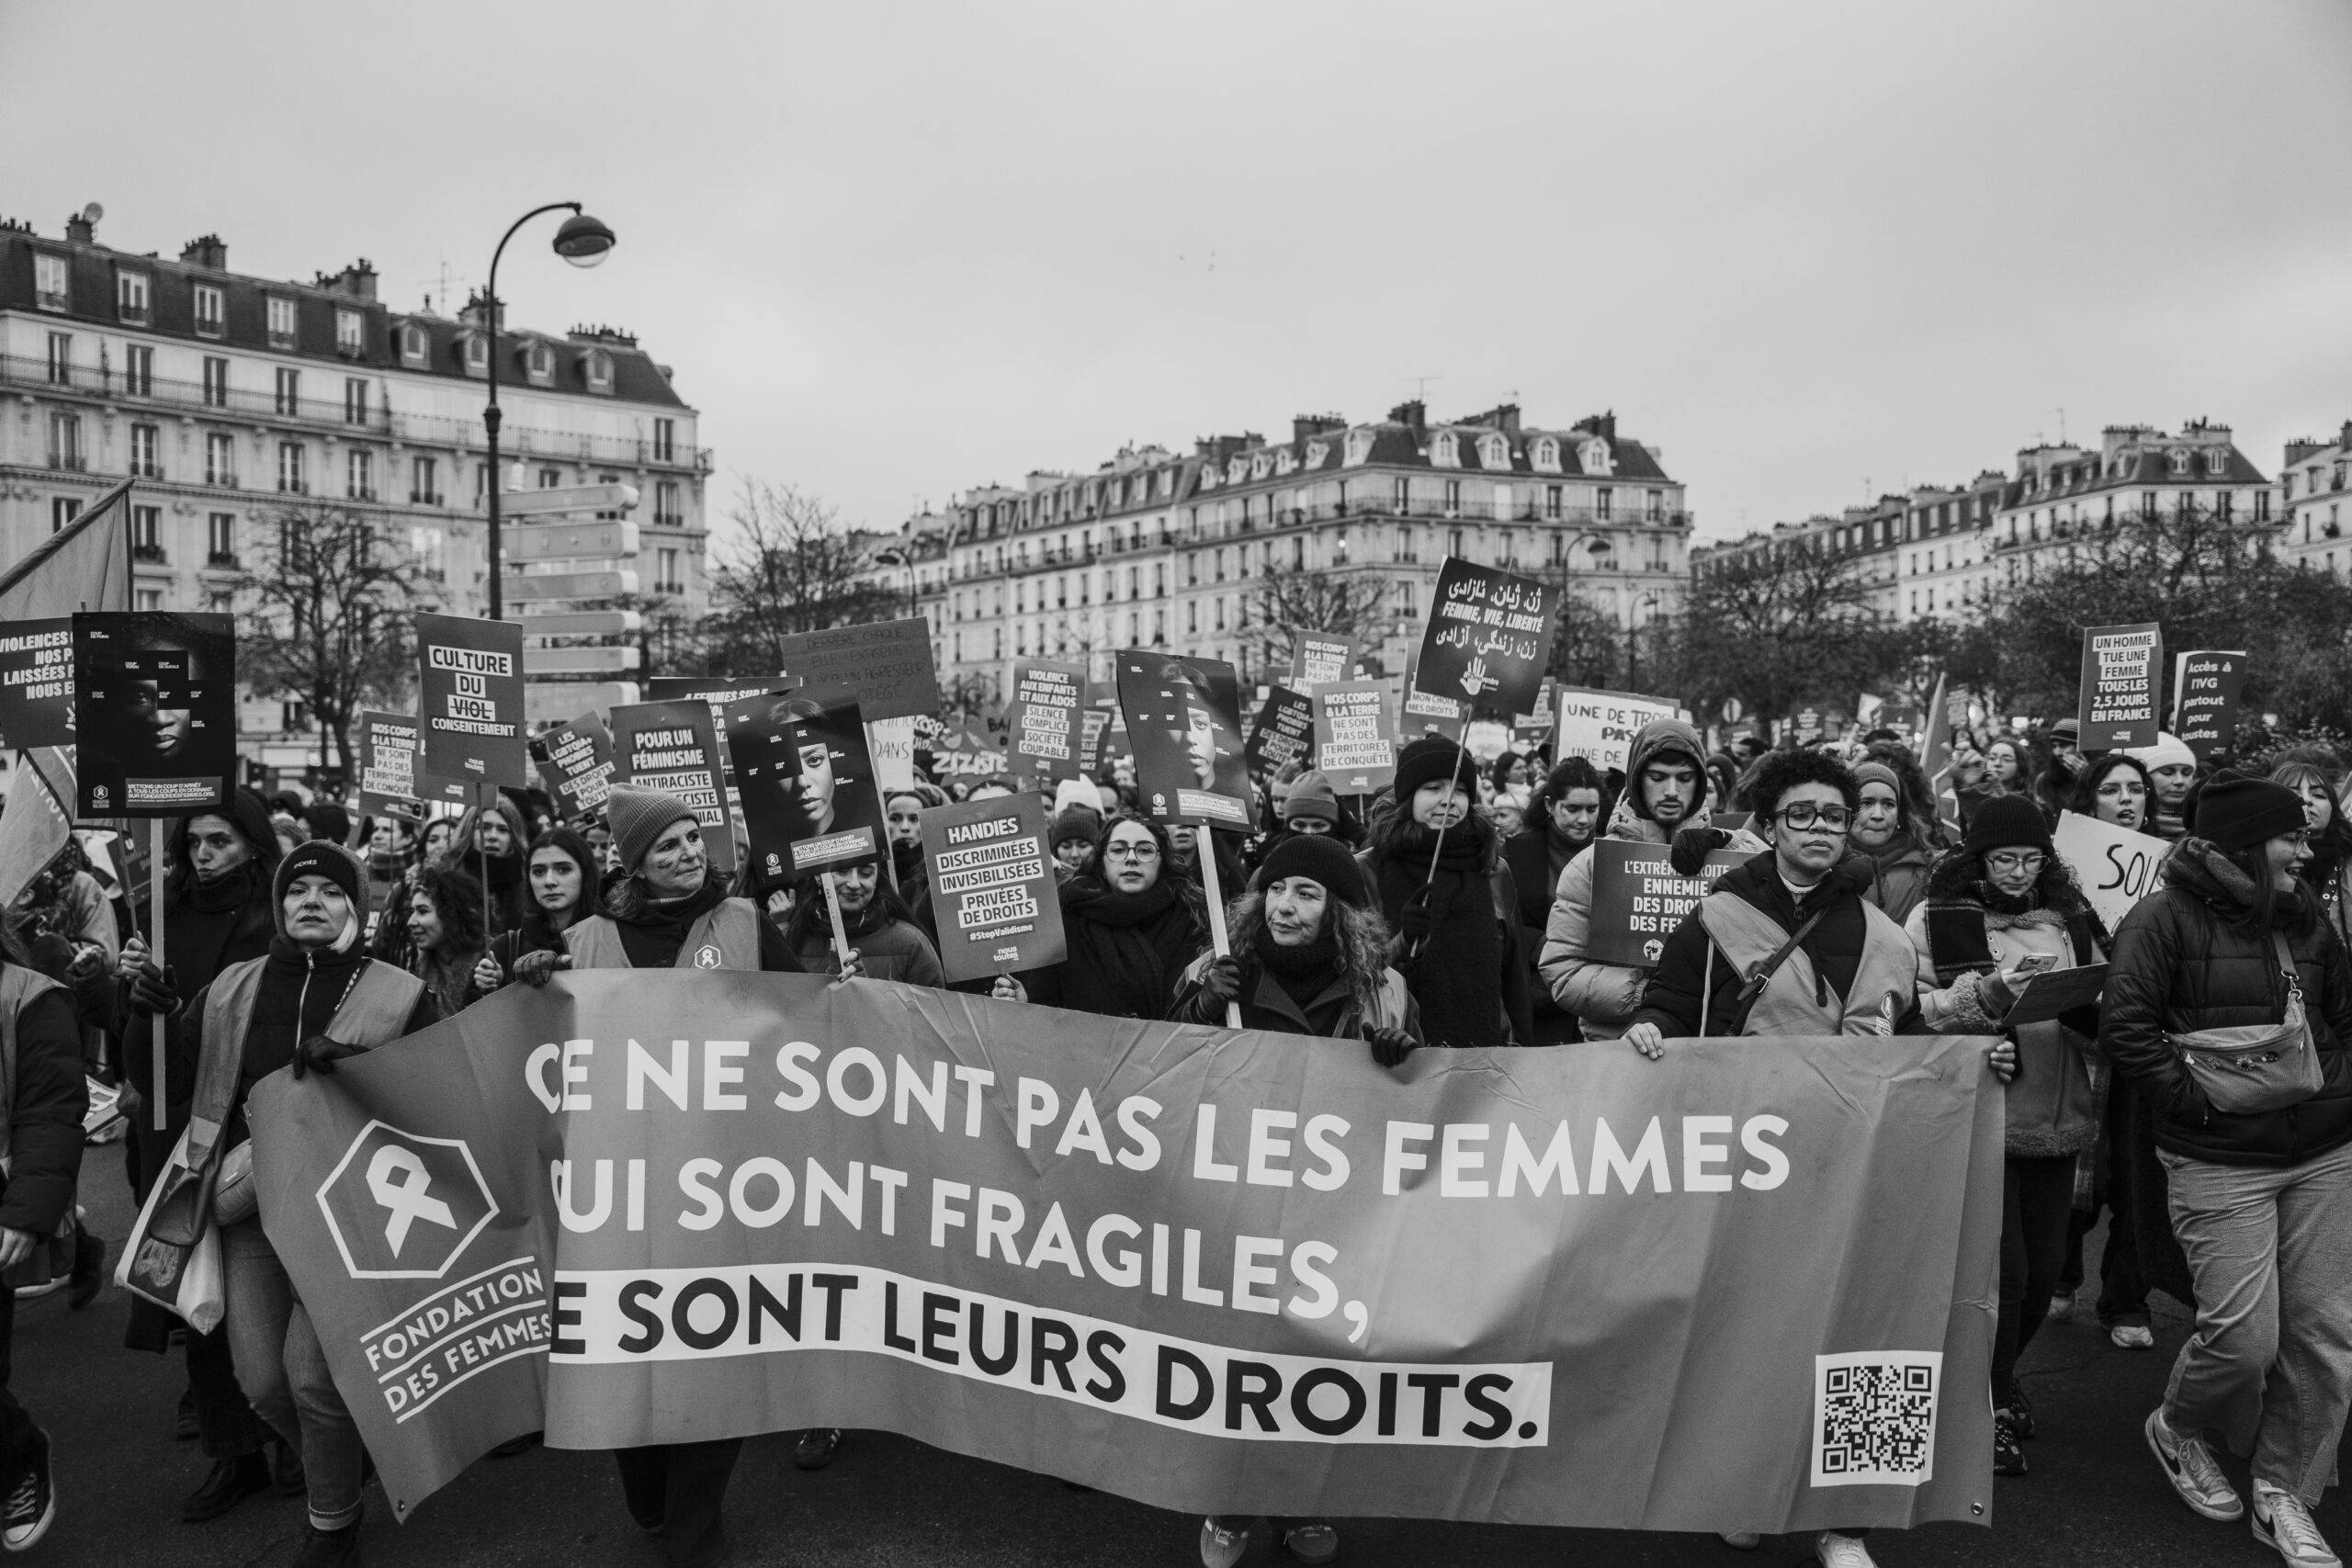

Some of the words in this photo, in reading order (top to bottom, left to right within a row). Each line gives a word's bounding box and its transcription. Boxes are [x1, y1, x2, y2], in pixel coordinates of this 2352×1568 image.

[1442, 601, 1481, 623] FEMME,
[1484, 609, 1504, 627] VIE,
[1506, 613, 1545, 634] LIBERTÉ
[1305, 640, 1323, 650] NOS
[1323, 643, 1349, 654] CORPS
[2096, 637, 2111, 649] UN
[2113, 635, 2152, 648] HOMME
[35, 649, 62, 665] NOS
[433, 648, 508, 674] CULTURE
[1311, 651, 1321, 660] LA
[1323, 652, 1347, 664] TERRE
[2103, 651, 2124, 662] TUE
[2126, 649, 2146, 661] UNE
[1319, 663, 1340, 672] SONT
[2105, 664, 2143, 678] FEMME
[2188, 660, 2219, 674] Accès
[2222, 661, 2233, 672] à
[4, 665, 65, 686] LAISSÉES
[1028, 670, 1069, 683] VIOLENCE
[26, 682, 56, 700] NOUS
[459, 676, 481, 694] DU
[857, 681, 905, 703] OTÉGÉ
[1020, 680, 1039, 691] AUX
[1038, 682, 1077, 696] ENFANTS
[2097, 680, 2129, 693] TOUS
[2130, 679, 2148, 692] LES
[1019, 691, 1031, 702] ET
[1031, 692, 1049, 705] AUX
[1050, 694, 1077, 708] ADOS
[1324, 694, 1346, 705] NOS
[1347, 692, 1380, 704] CORPS
[1412, 694, 1430, 703] MON
[2093, 695, 2112, 708] 2,5
[2112, 694, 2149, 706] JOURS
[2183, 695, 2224, 711] partout
[453, 699, 491, 719] VIOL
[1029, 705, 1064, 719] SILENCE
[1326, 706, 1334, 717] &
[1335, 706, 1350, 716] LA
[1351, 705, 1381, 716] TERRE
[1408, 704, 1425, 712] MES
[1425, 705, 1453, 715] DROITS
[1567, 704, 1601, 719] UNE
[1608, 707, 1626, 724] DE
[2091, 710, 2107, 722] EN
[2108, 707, 2152, 721] FRANCE
[432, 716, 515, 737] CONSENTEMENT
[1023, 716, 1068, 731] COMPLICE
[1334, 719, 1347, 728] NE
[1348, 718, 1374, 728] SONT
[2187, 713, 2212, 727] pour
[371, 723, 390, 733] NOS
[390, 726, 417, 738] CORPS
[558, 730, 576, 745] LES
[635, 731, 673, 749] POUR
[673, 728, 694, 745] UN
[1336, 731, 1356, 740] PAS
[1359, 730, 1375, 739] DES
[1601, 727, 1636, 743] PAS
[379, 736, 390, 746] LA
[390, 738, 416, 750] TERRE
[1021, 742, 1067, 758] COUPABLE
[1324, 742, 1387, 754] TERRITOIRES
[389, 750, 411, 759] SONT
[632, 748, 705, 771] FÉMINISME
[1324, 758, 1337, 766] DE
[1338, 754, 1390, 766] CONQUÊTE
[1604, 750, 1623, 763] DE
[378, 760, 393, 770] PAS
[395, 761, 410, 772] DES
[565, 756, 596, 776] TUENT
[367, 769, 414, 783] TERRITOIRE
[562, 779, 581, 793] DES
[579, 765, 613, 784] DROITS
[366, 781, 376, 789] DE
[580, 779, 605, 796] POUR
[579, 786, 611, 808] TOUTE
[947, 818, 1019, 844] HANDIES
[940, 840, 1036, 870] DISCRIMINÉES
[1624, 859, 1683, 876] L'EXTRÊM
[942, 862, 1041, 891] INVISIBILISÉES
[1644, 877, 1709, 897] ENNEMIE
[967, 887, 1023, 909] PRIVÉES
[1634, 896, 1661, 914] DES
[963, 908, 982, 925] DE
[983, 901, 1035, 923] DROITS
[1630, 915, 1657, 932] DES
[969, 922, 1034, 942] #StopValidisme
[993, 952, 1019, 962] toutes
[998, 946, 1018, 955] nous
[626, 1038, 750, 1111] NE
[774, 1039, 994, 1138] SONT
[1016, 1076, 1163, 1172] PAS
[1193, 1102, 1352, 1192] LES
[1382, 1113, 1792, 1198] FEMMES
[550, 1158, 646, 1234] UI
[677, 1156, 908, 1236] SONT
[930, 1177, 1369, 1344] FRAGILES,
[365, 1268, 544, 1372] FONDATION
[383, 1362, 439, 1414] DES
[444, 1314, 552, 1374] FEMMES
[551, 1281, 588, 1357] E
[617, 1272, 859, 1354] SONT
[884, 1280, 1127, 1404] LEURS
[1155, 1343, 1539, 1441] DROITS.
